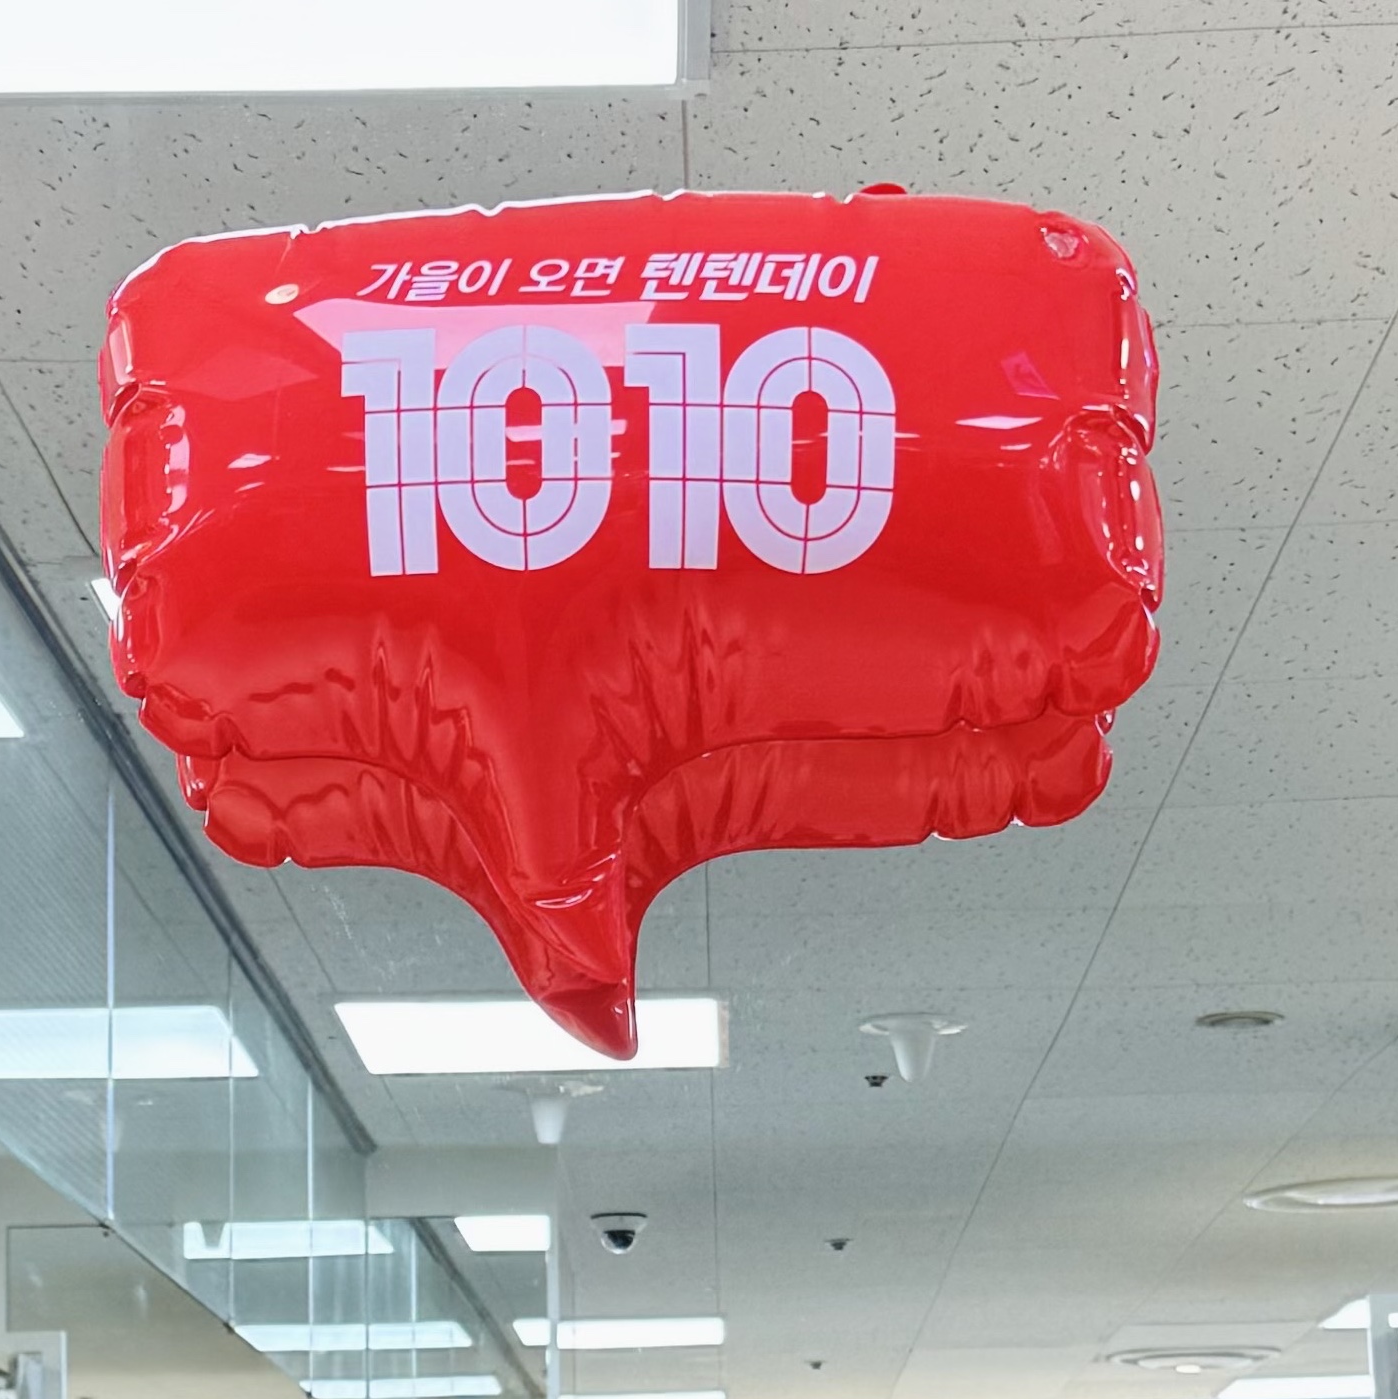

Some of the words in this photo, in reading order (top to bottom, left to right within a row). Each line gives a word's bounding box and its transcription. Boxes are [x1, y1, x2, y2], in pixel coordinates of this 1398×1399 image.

[357, 258, 510, 302] 가을이
[518, 255, 626, 297] 오면
[639, 251, 880, 304] 텐텐데이
